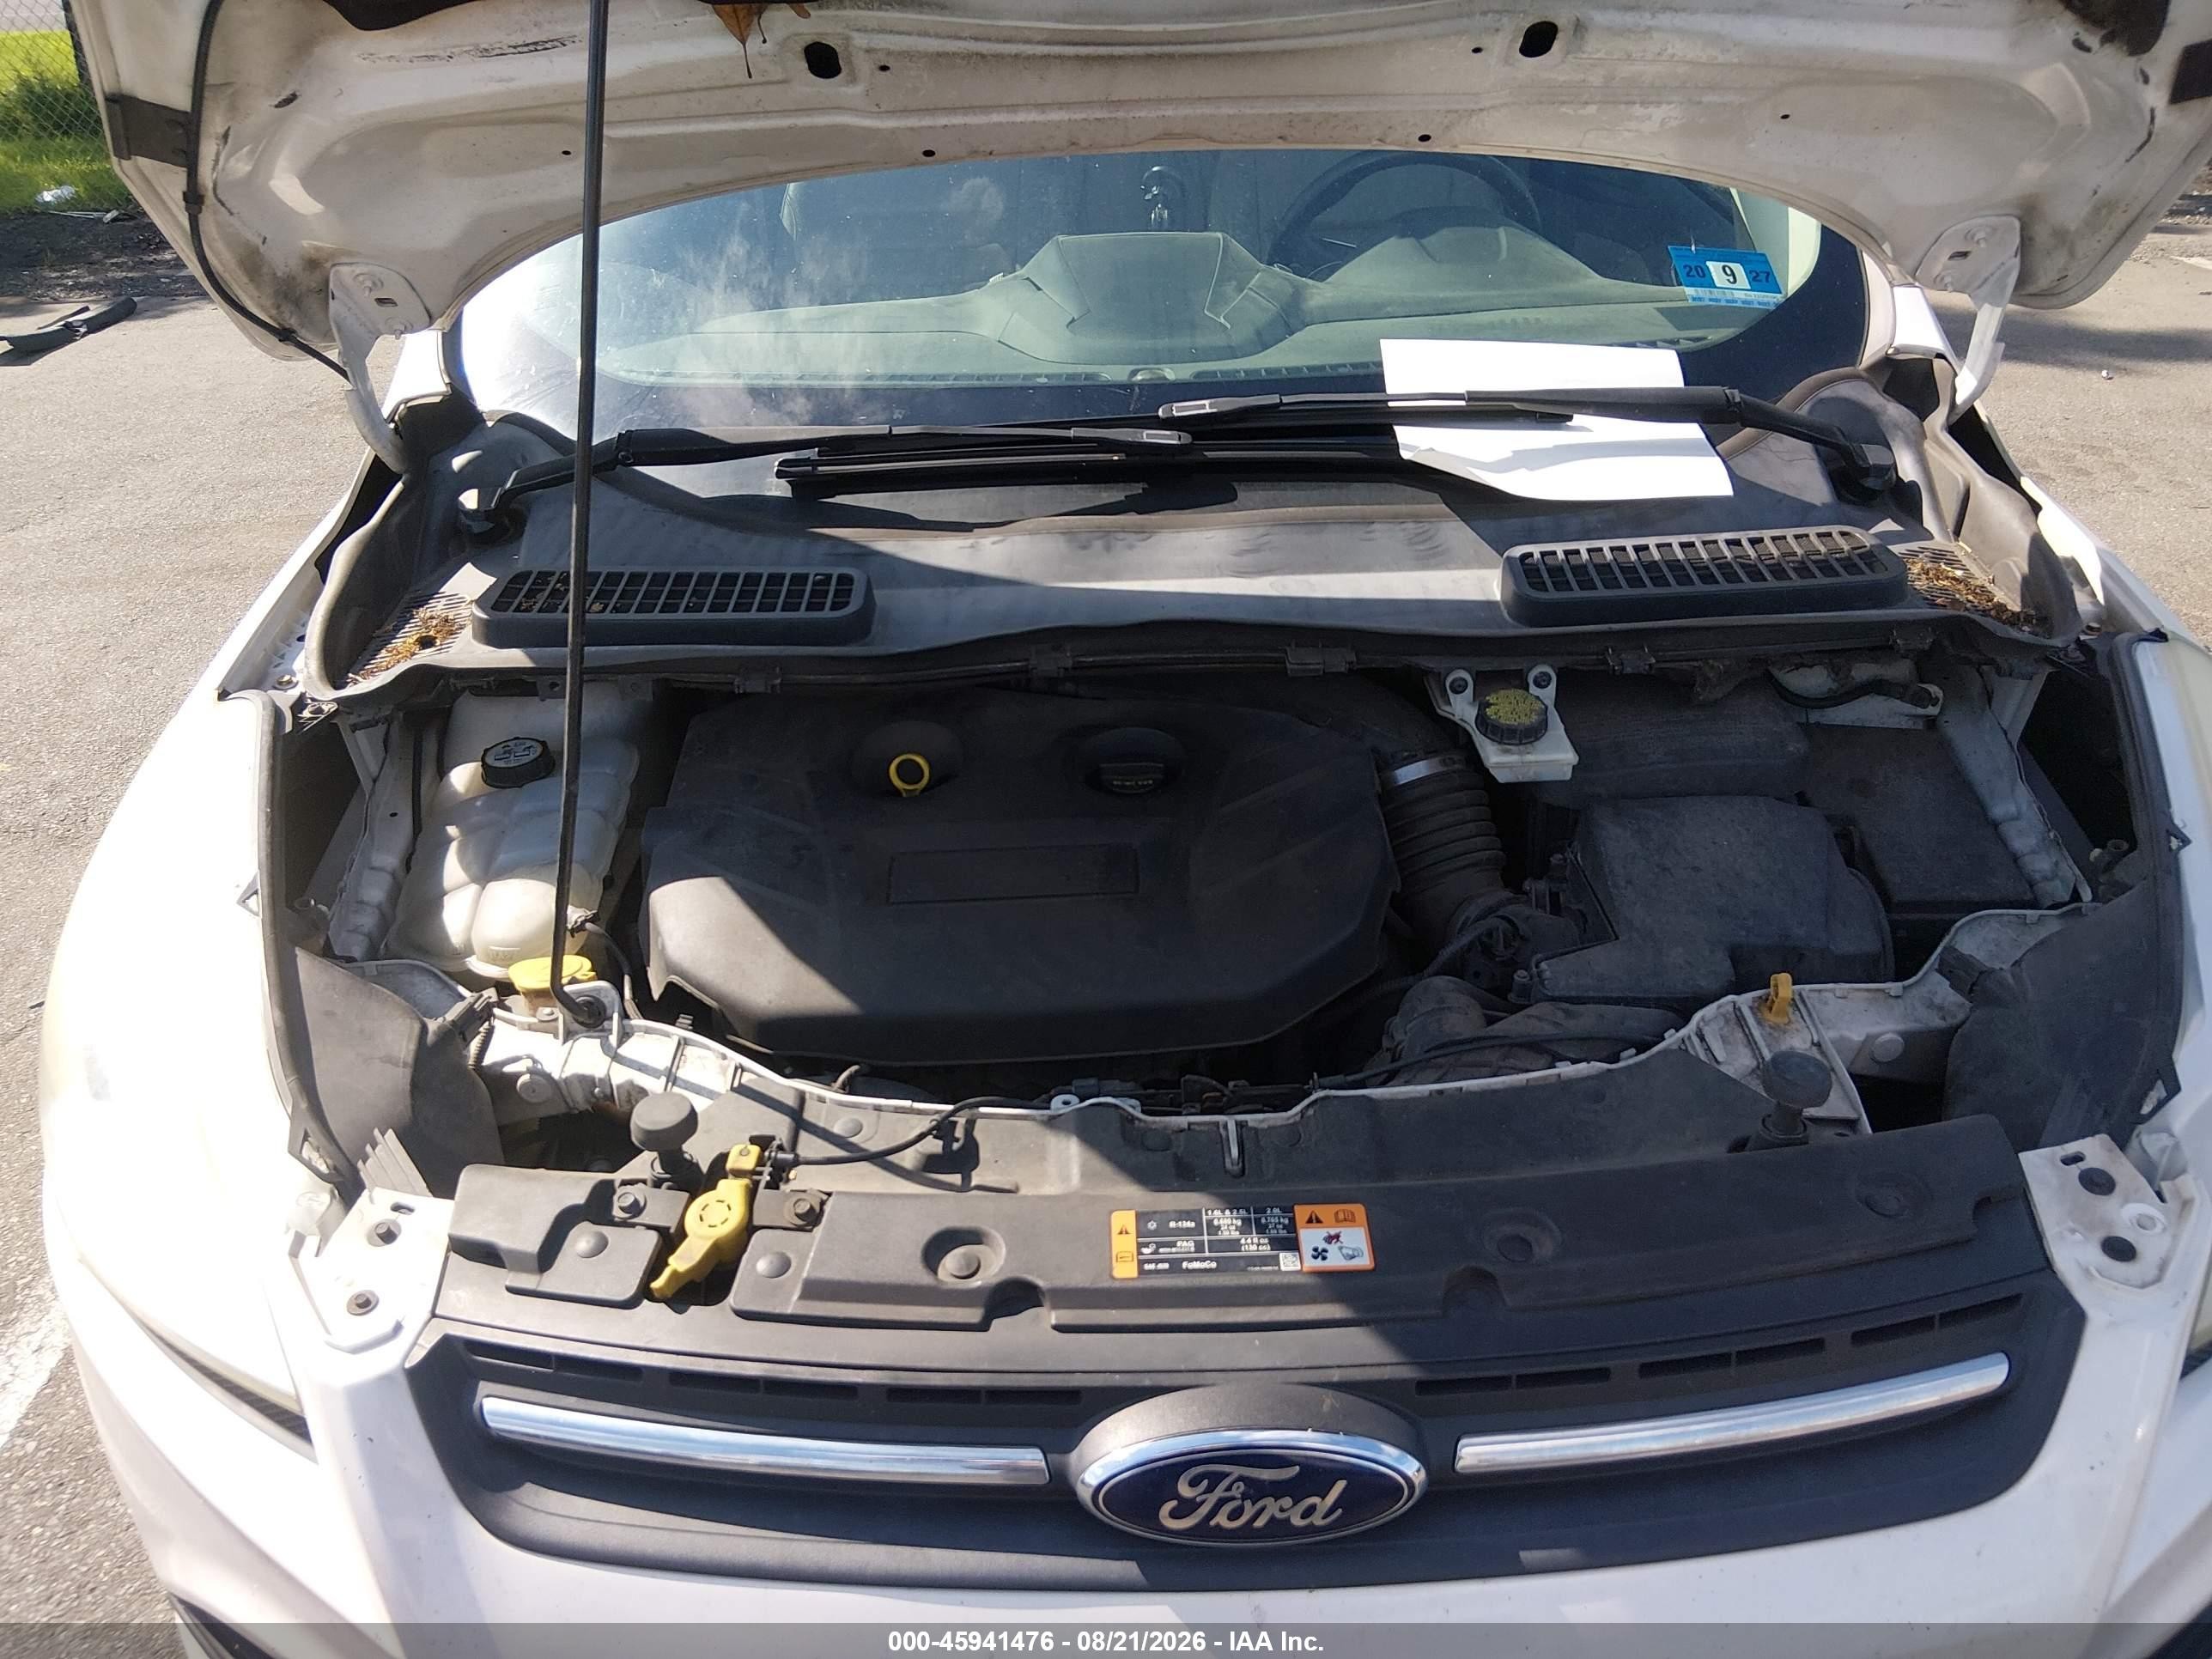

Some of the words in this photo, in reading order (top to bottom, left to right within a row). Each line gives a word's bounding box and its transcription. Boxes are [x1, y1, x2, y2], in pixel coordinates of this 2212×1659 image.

[1682, 264, 1706, 278] 20
[1722, 264, 1738, 285] 9
[1182, 1260, 1217, 1270] FoMoCo
[1159, 1463, 1348, 1530] Ford
